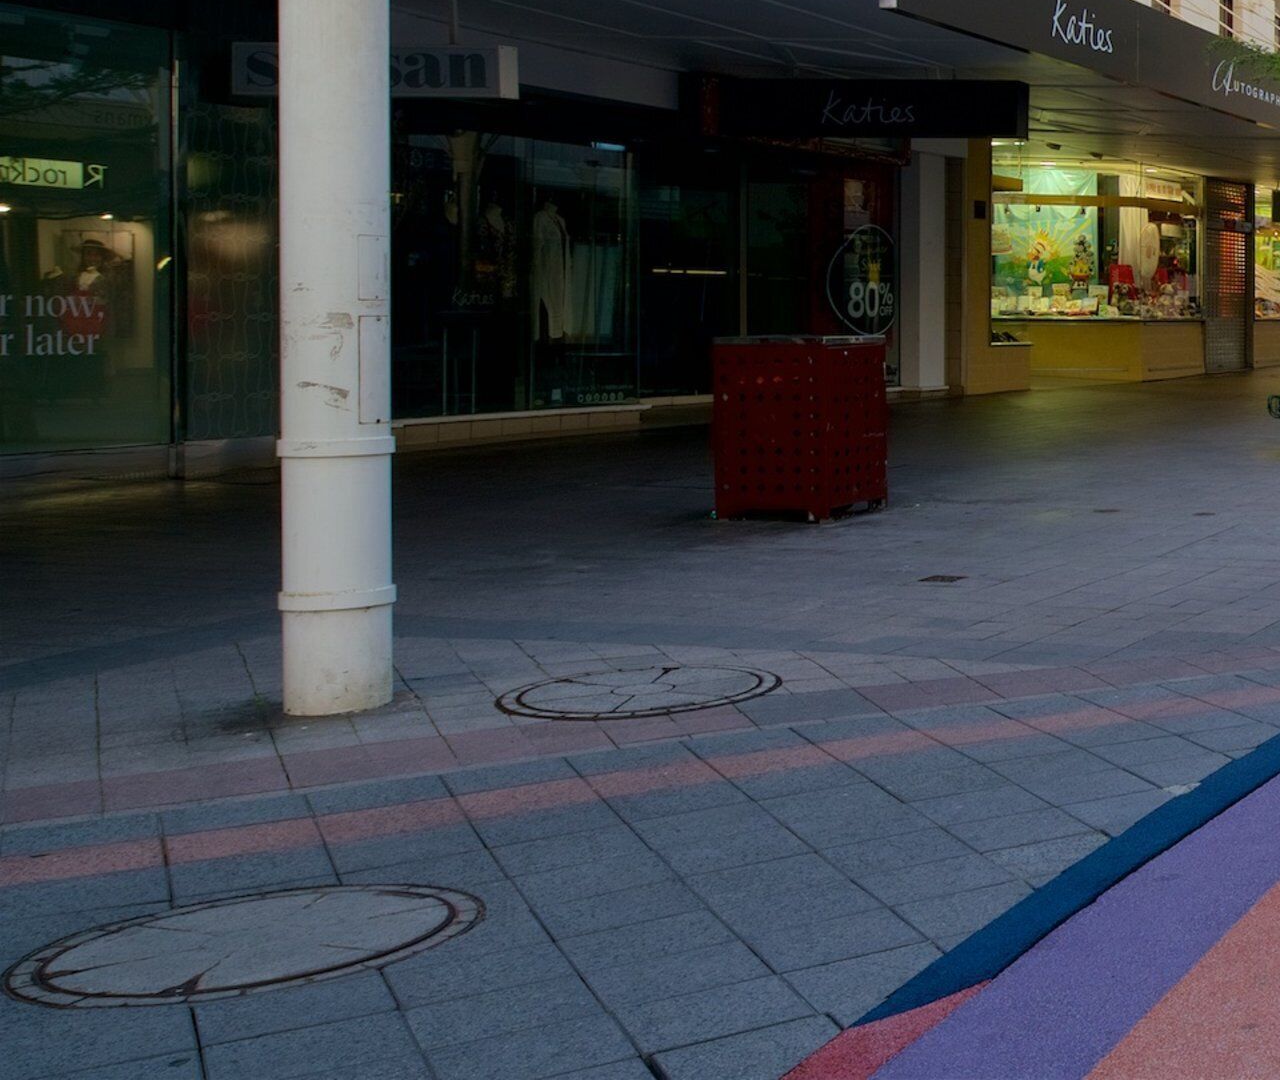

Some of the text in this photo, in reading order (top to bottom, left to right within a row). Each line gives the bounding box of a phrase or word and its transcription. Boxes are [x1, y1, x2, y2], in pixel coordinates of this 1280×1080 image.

[821, 88, 916, 126] Katies
[25, 294, 104, 322] now,
[847, 281, 893, 318] 80%
[879, 306, 893, 317] OFF
[26, 323, 100, 356] later
